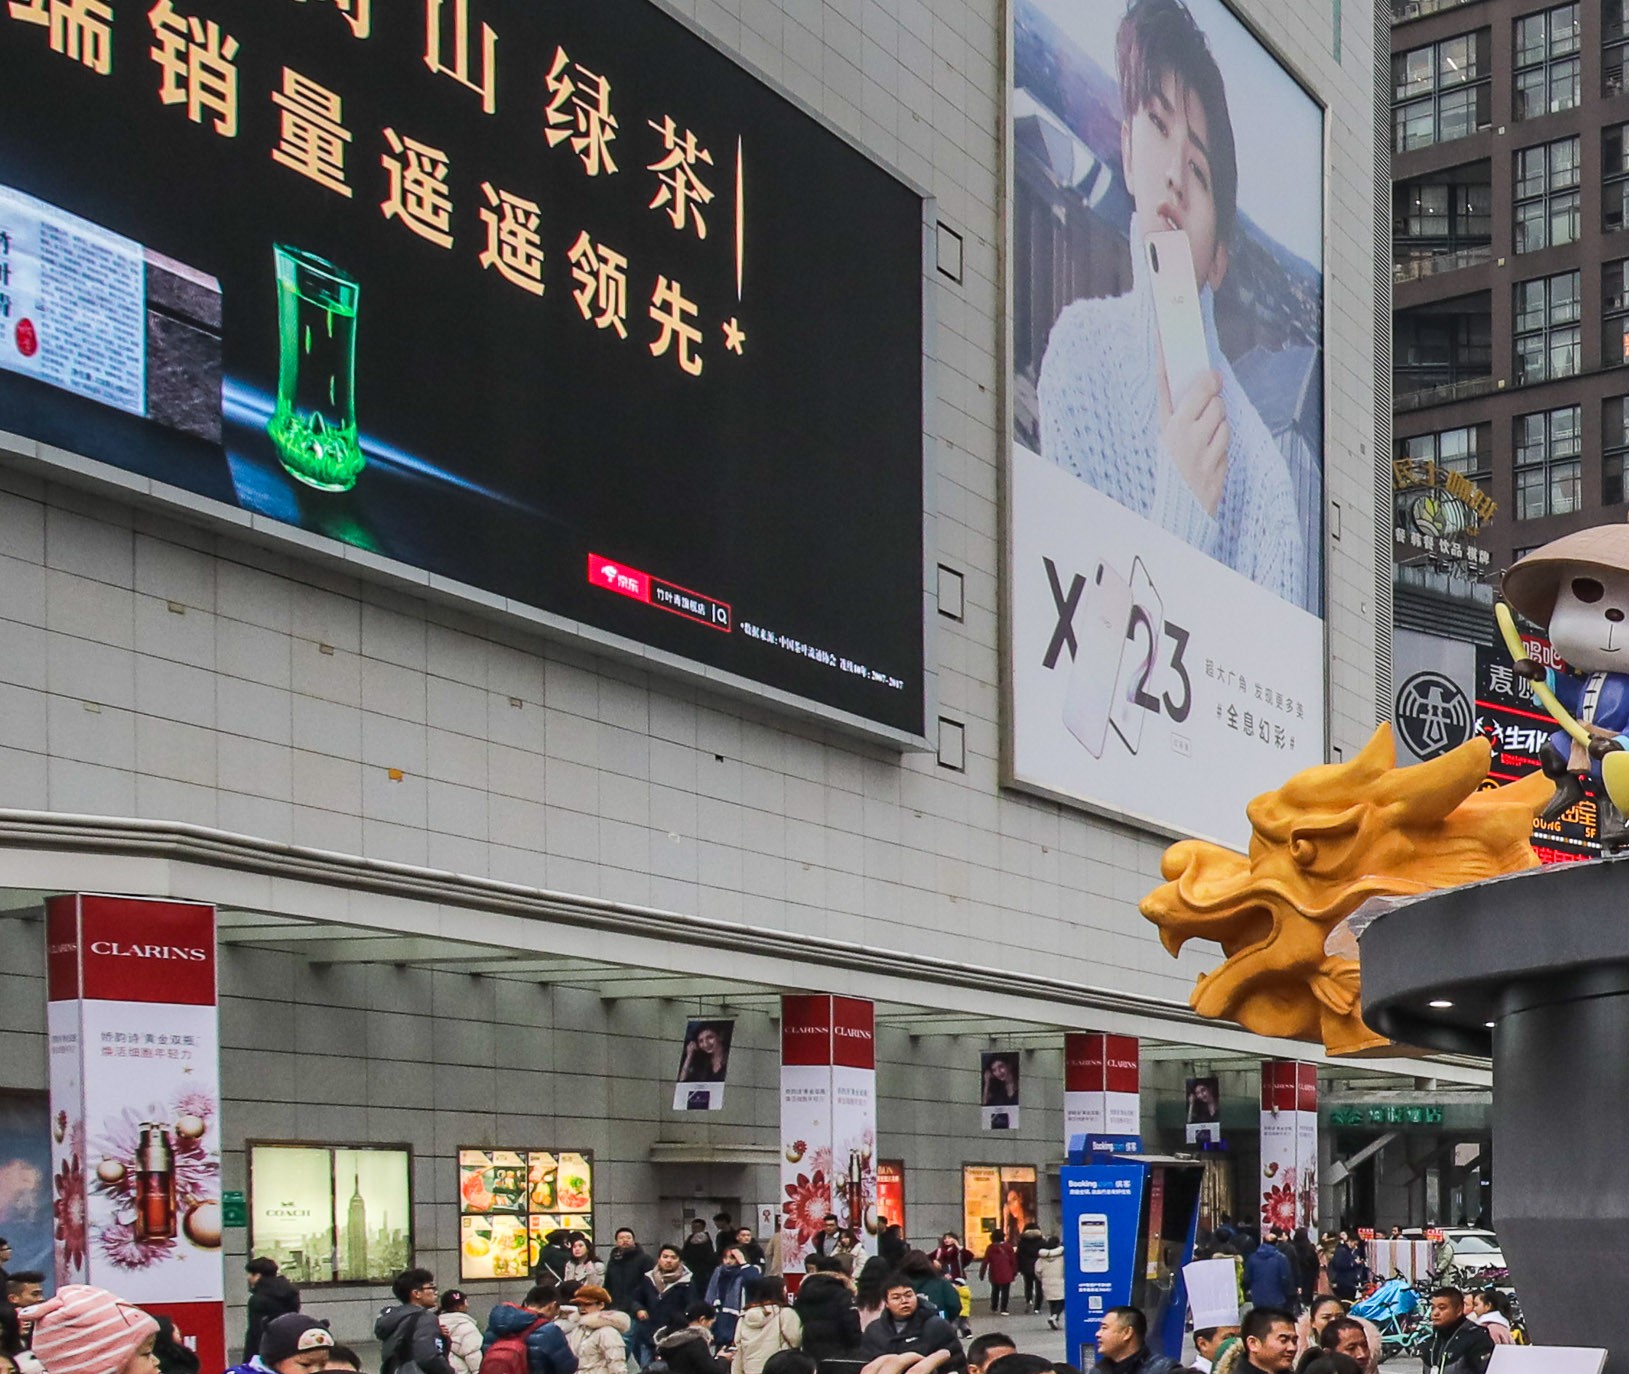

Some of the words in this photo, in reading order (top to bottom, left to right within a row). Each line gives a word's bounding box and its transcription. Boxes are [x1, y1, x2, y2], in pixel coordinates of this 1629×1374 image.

[617, 574, 640, 594] 京东
[91, 941, 206, 962] CLARINS
[834, 1026, 873, 1040] CLARINS
[265, 1209, 311, 1217] COACH
